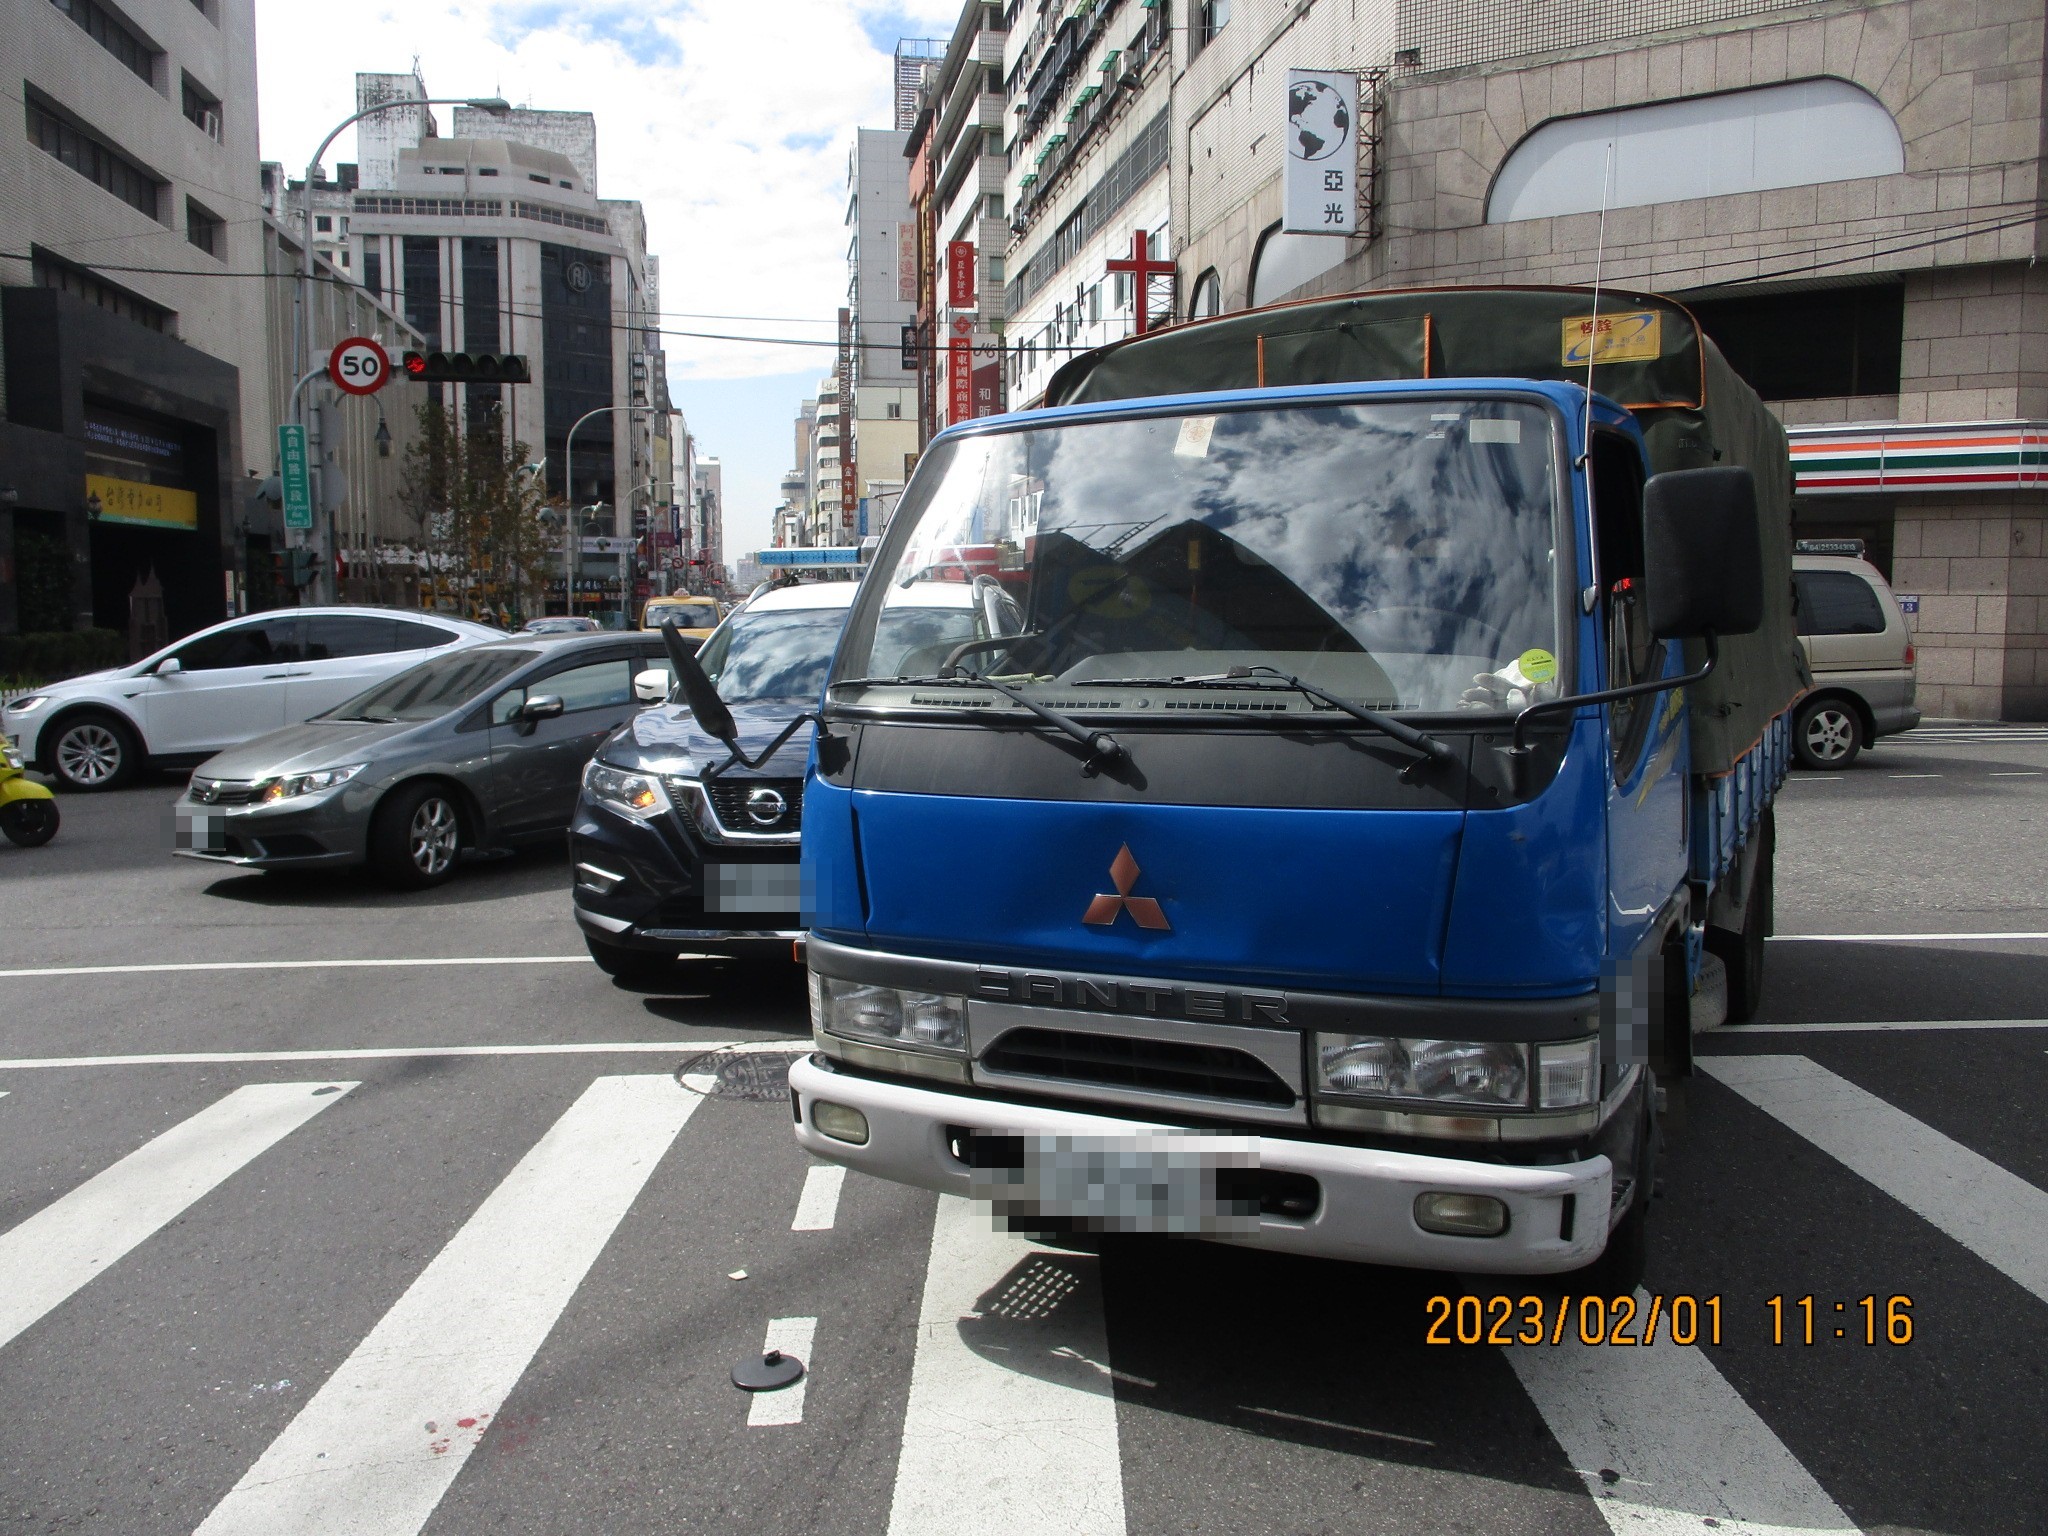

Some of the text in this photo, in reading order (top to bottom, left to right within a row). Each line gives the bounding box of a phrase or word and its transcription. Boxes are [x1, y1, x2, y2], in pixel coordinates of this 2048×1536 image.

[1324, 170, 1344, 224] 亞光
[900, 224, 915, 276] 阿曼達
[343, 356, 378, 376] 50
[287, 436, 302, 501] 自由路二段
[972, 968, 1289, 1023] CANTER
